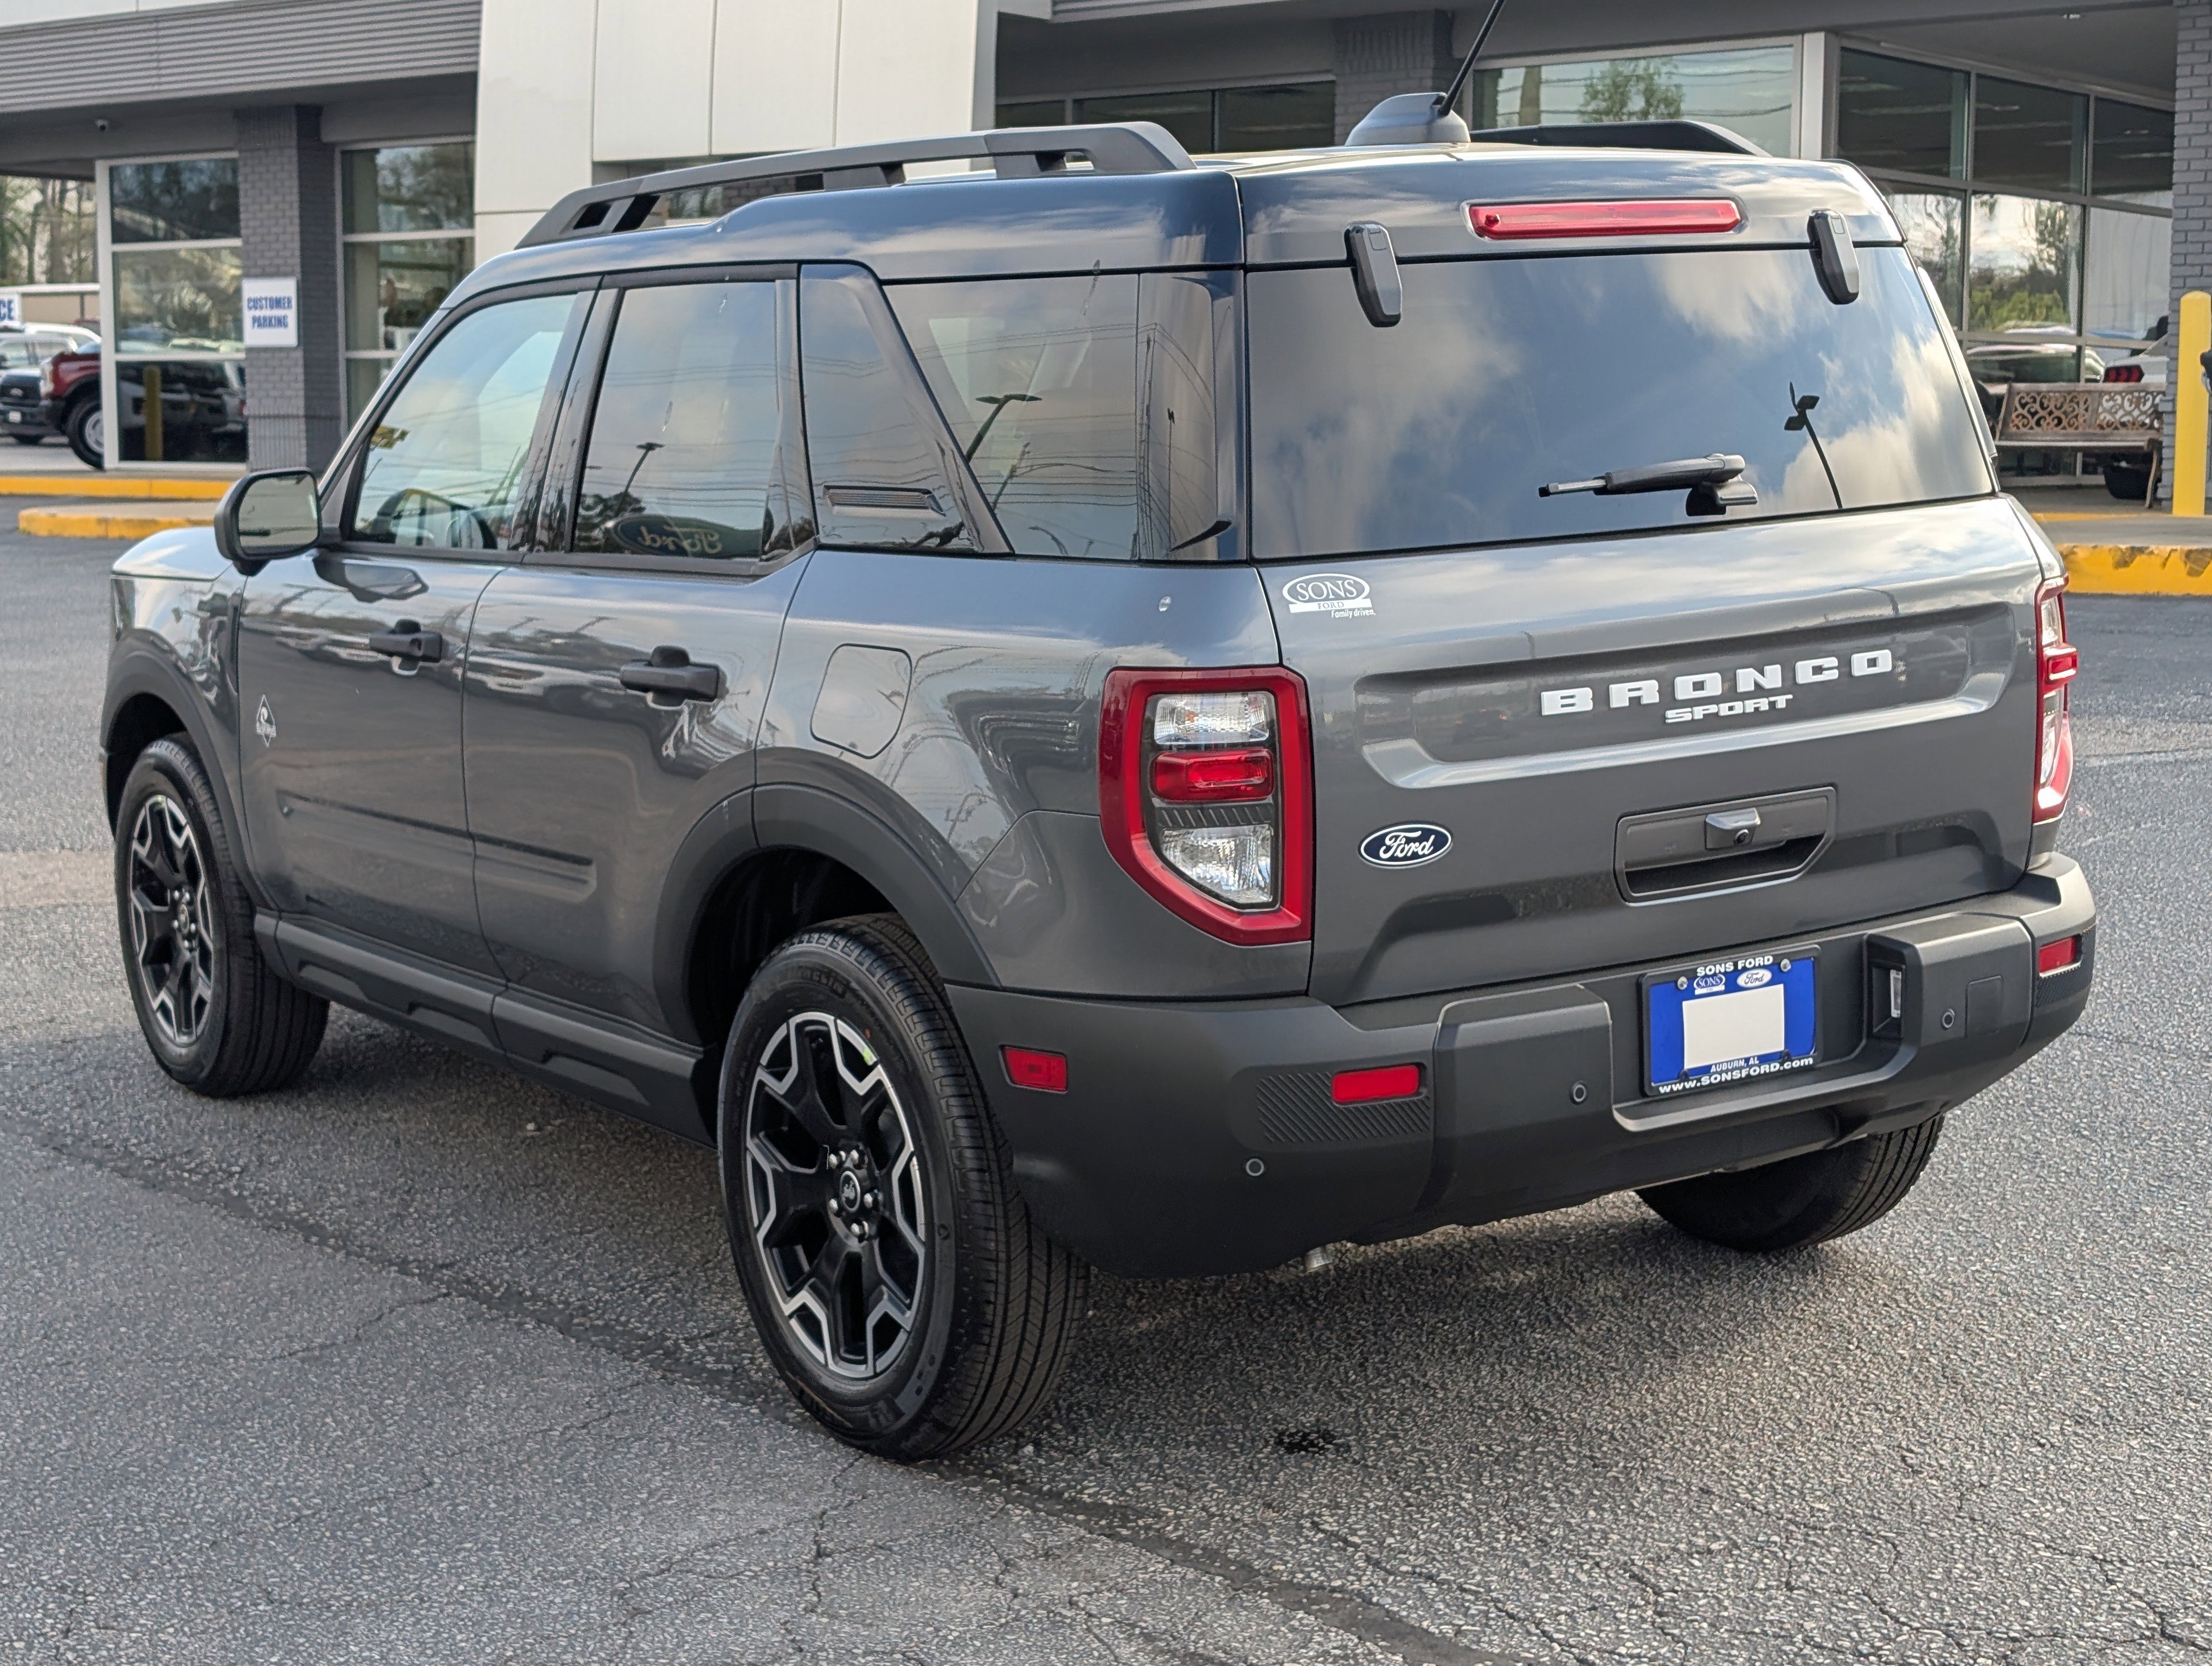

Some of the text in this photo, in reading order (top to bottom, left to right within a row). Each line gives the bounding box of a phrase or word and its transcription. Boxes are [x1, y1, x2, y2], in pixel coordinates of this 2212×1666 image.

[247, 296, 292, 310] CUSTOMER
[252, 315, 288, 329] PARKING
[1296, 580, 1357, 600] SONS
[1332, 610, 1353, 619] Family
[1541, 650, 1892, 716] BRONCO
[1665, 695, 1793, 723] SPORT
[1379, 830, 1435, 859] Ford
[1697, 955, 1773, 976] SONS FORD
[1699, 972, 1764, 988] SONS Ford
[1659, 1057, 1813, 1093] www.SONSFORD.com
[1710, 1057, 1759, 1073] AUBURN, AL
